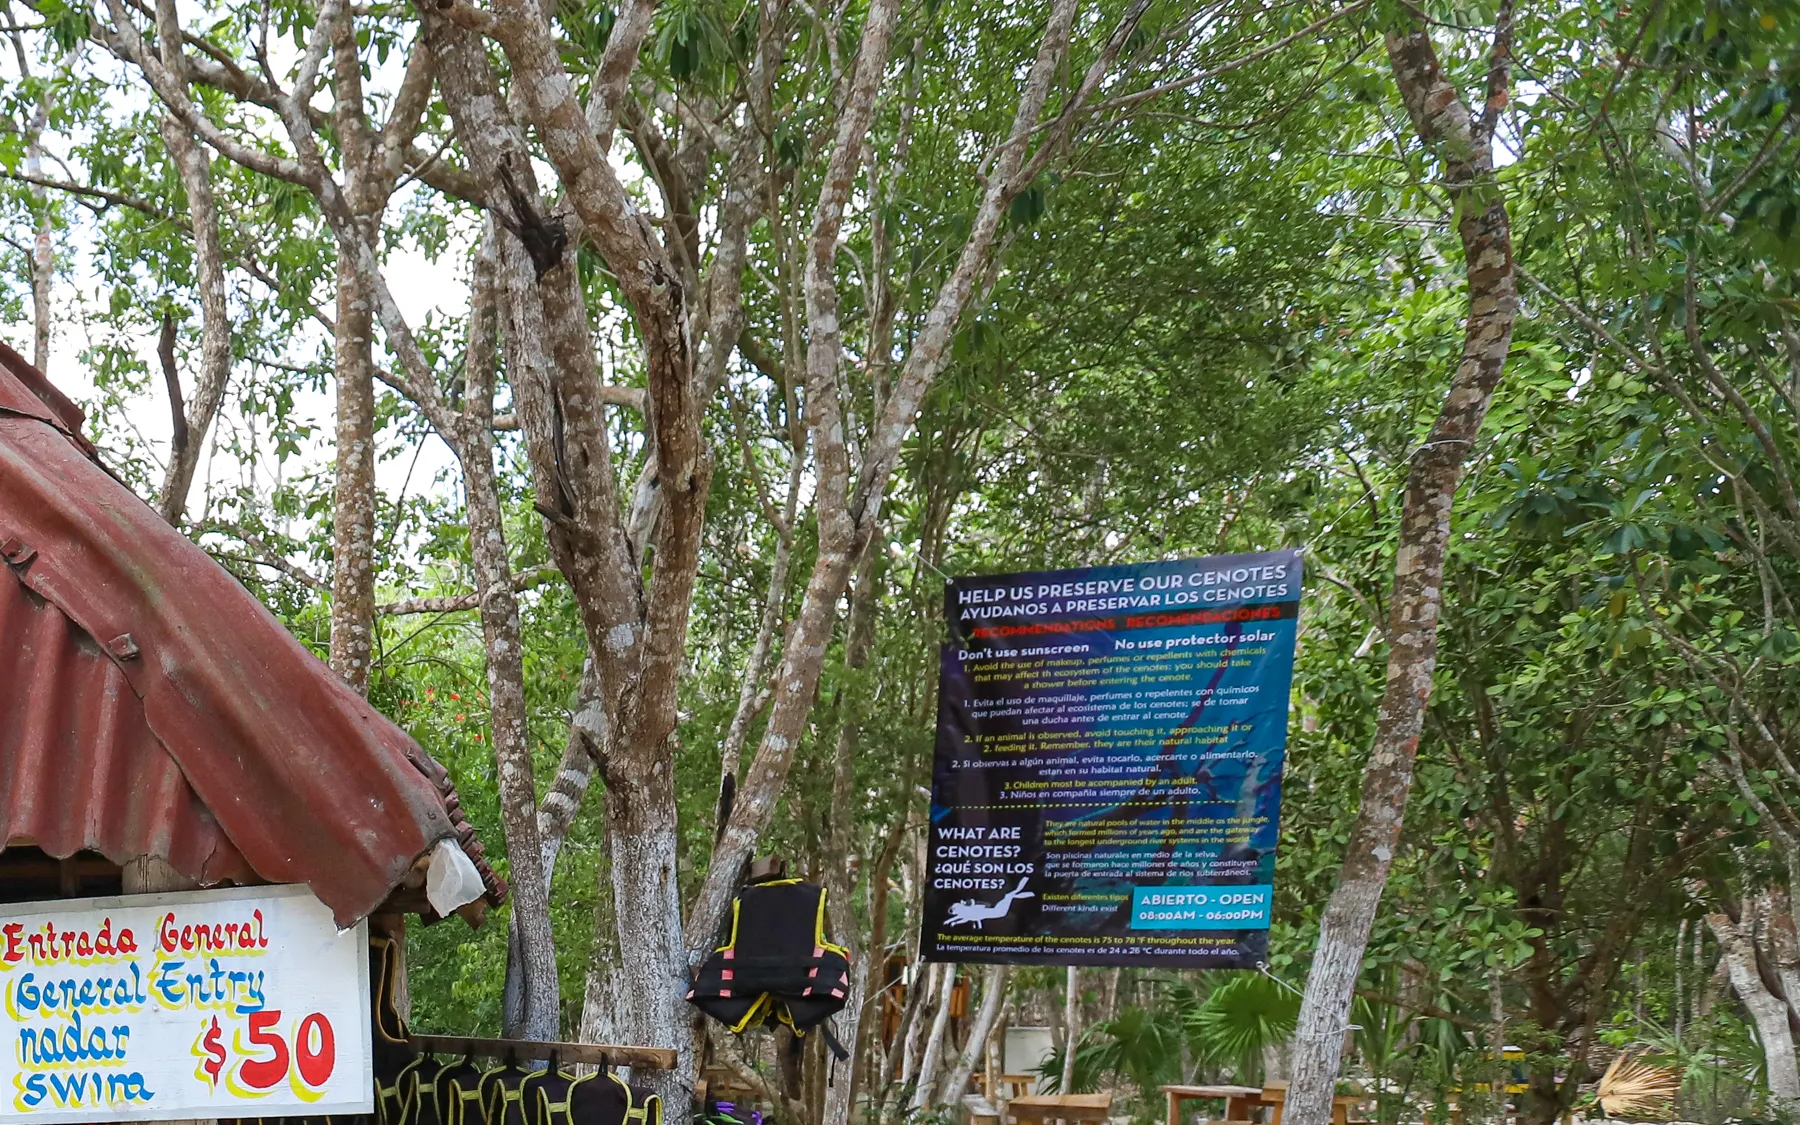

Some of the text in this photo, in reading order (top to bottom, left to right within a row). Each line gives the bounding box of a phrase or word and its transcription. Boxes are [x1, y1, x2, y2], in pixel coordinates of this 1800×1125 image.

[958, 565, 1286, 604] HELP US PRESERVE OUR CENOTES
[961, 584, 1287, 621] AYUDANOS PRESERVAR LOS CENOTES
[1115, 631, 1275, 650] No use protector solar
[995, 647, 1018, 658] use
[1022, 643, 1089, 656] sunscreen
[939, 827, 1020, 840] WHAT ARE
[937, 845, 1020, 858] CENOTES?
[975, 862, 1005, 874] SON
[1007, 862, 1033, 873] LOS
[934, 878, 1005, 889] CENOTES?
[1141, 893, 1264, 905] ABIERTO OPEN
[1139, 909, 1263, 920] 08:00AM 06:00PM
[3, 909, 269, 961] Entrada General
[17, 960, 265, 1014] General Entry
[21, 1012, 130, 1063] nadar
[204, 1010, 335, 1088] $50
